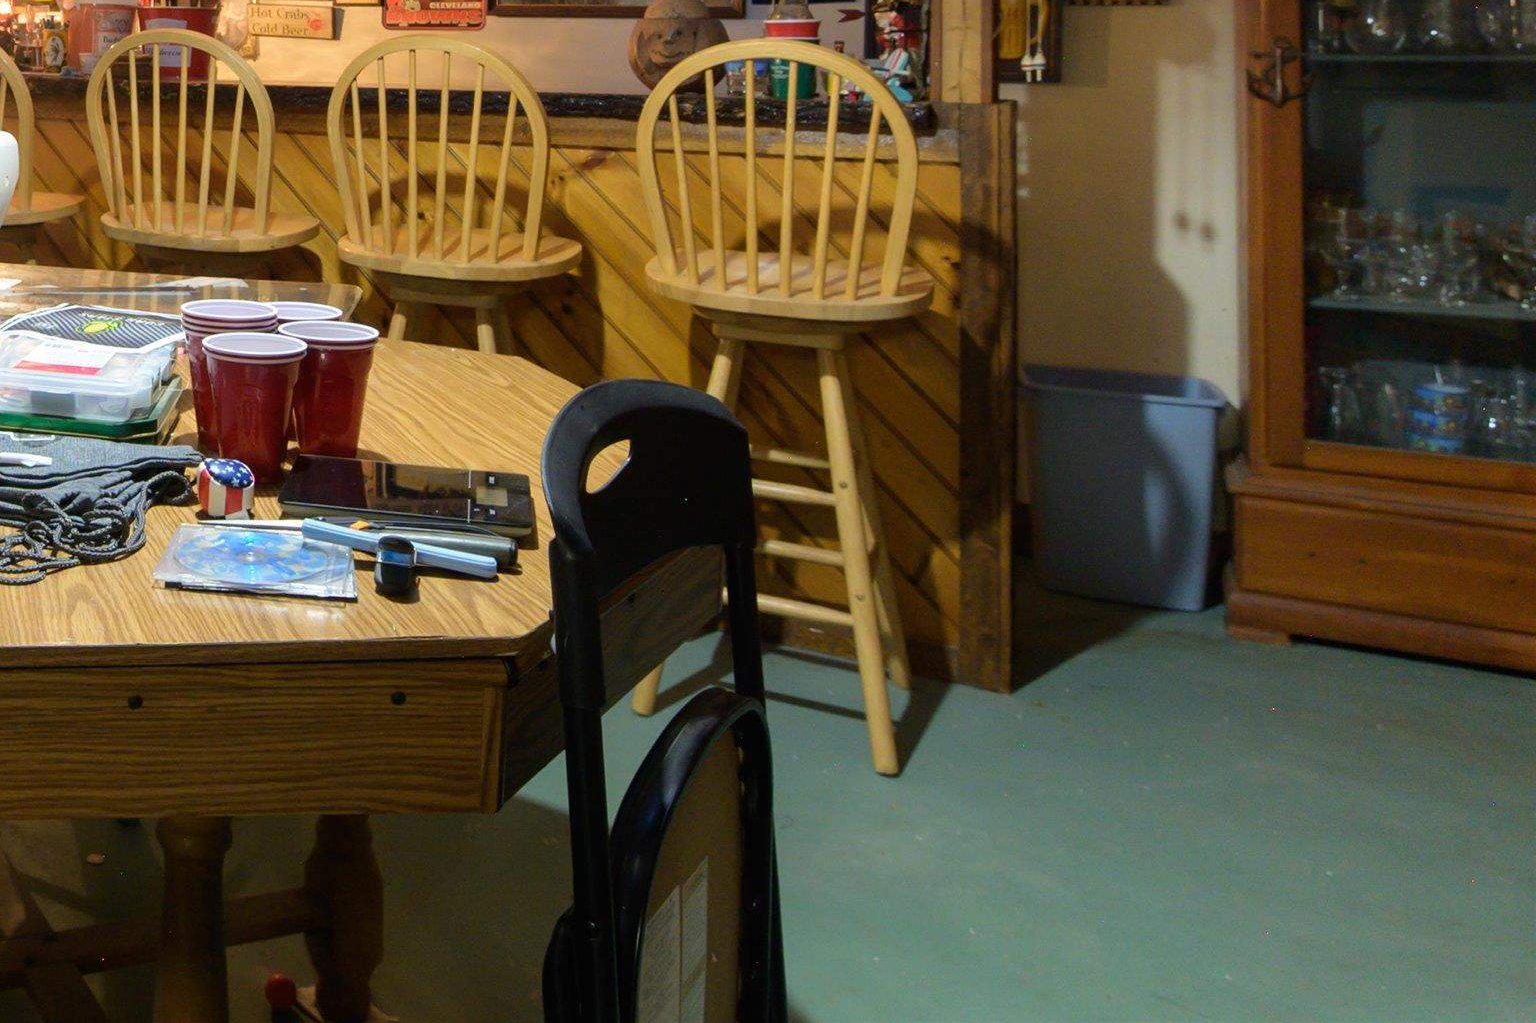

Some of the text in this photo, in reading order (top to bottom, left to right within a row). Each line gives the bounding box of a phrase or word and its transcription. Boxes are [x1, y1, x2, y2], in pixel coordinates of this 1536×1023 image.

[429, 1, 482, 9] CLEVELAND
[251, 7, 311, 19] Hot Crabs
[252, 22, 309, 35] Cold Beer
